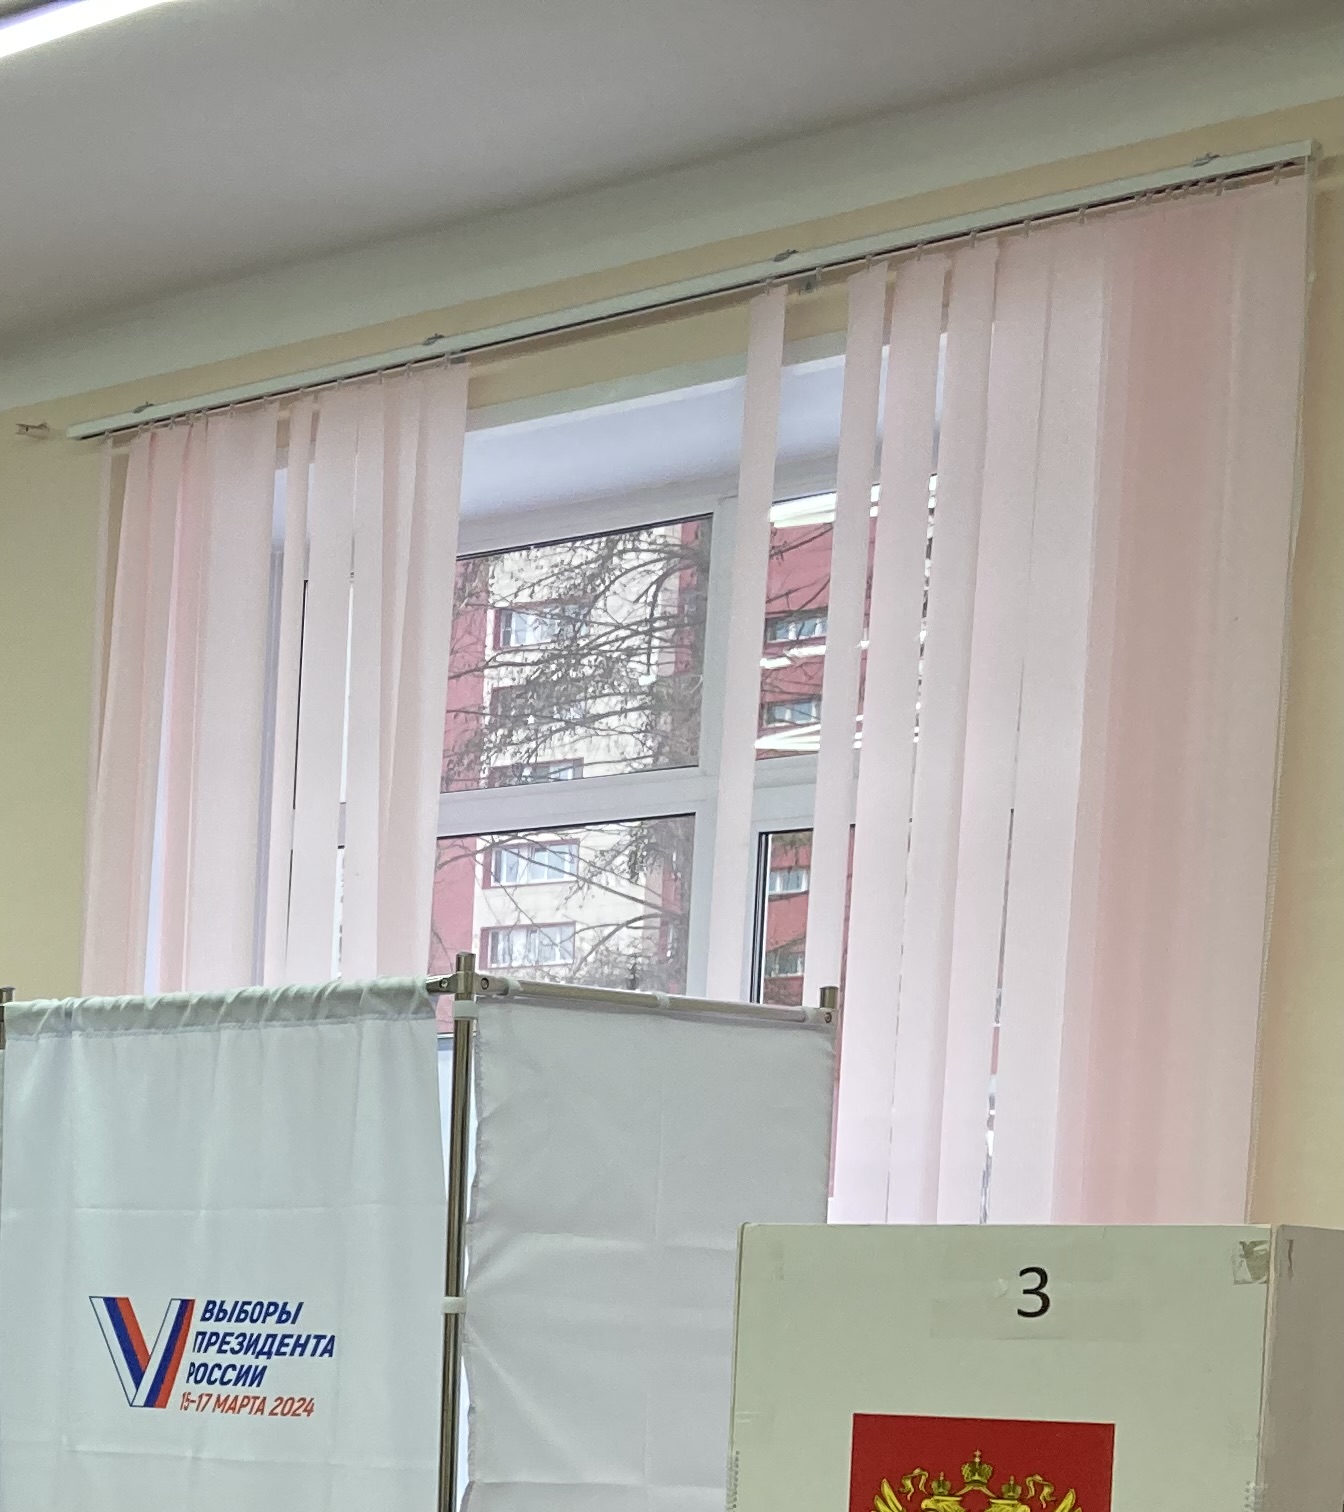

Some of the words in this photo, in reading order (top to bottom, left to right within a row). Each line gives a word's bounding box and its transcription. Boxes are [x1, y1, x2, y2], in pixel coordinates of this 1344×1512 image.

[1016, 1265, 1051, 1319] 3
[200, 1299, 304, 1325] ВЫБОРЫ
[192, 1330, 336, 1360] ПРЕЗИДЕНТА
[185, 1361, 268, 1388] РОССИИ
[213, 1393, 265, 1416] МАРТА
[268, 1396, 315, 1418] 2024
